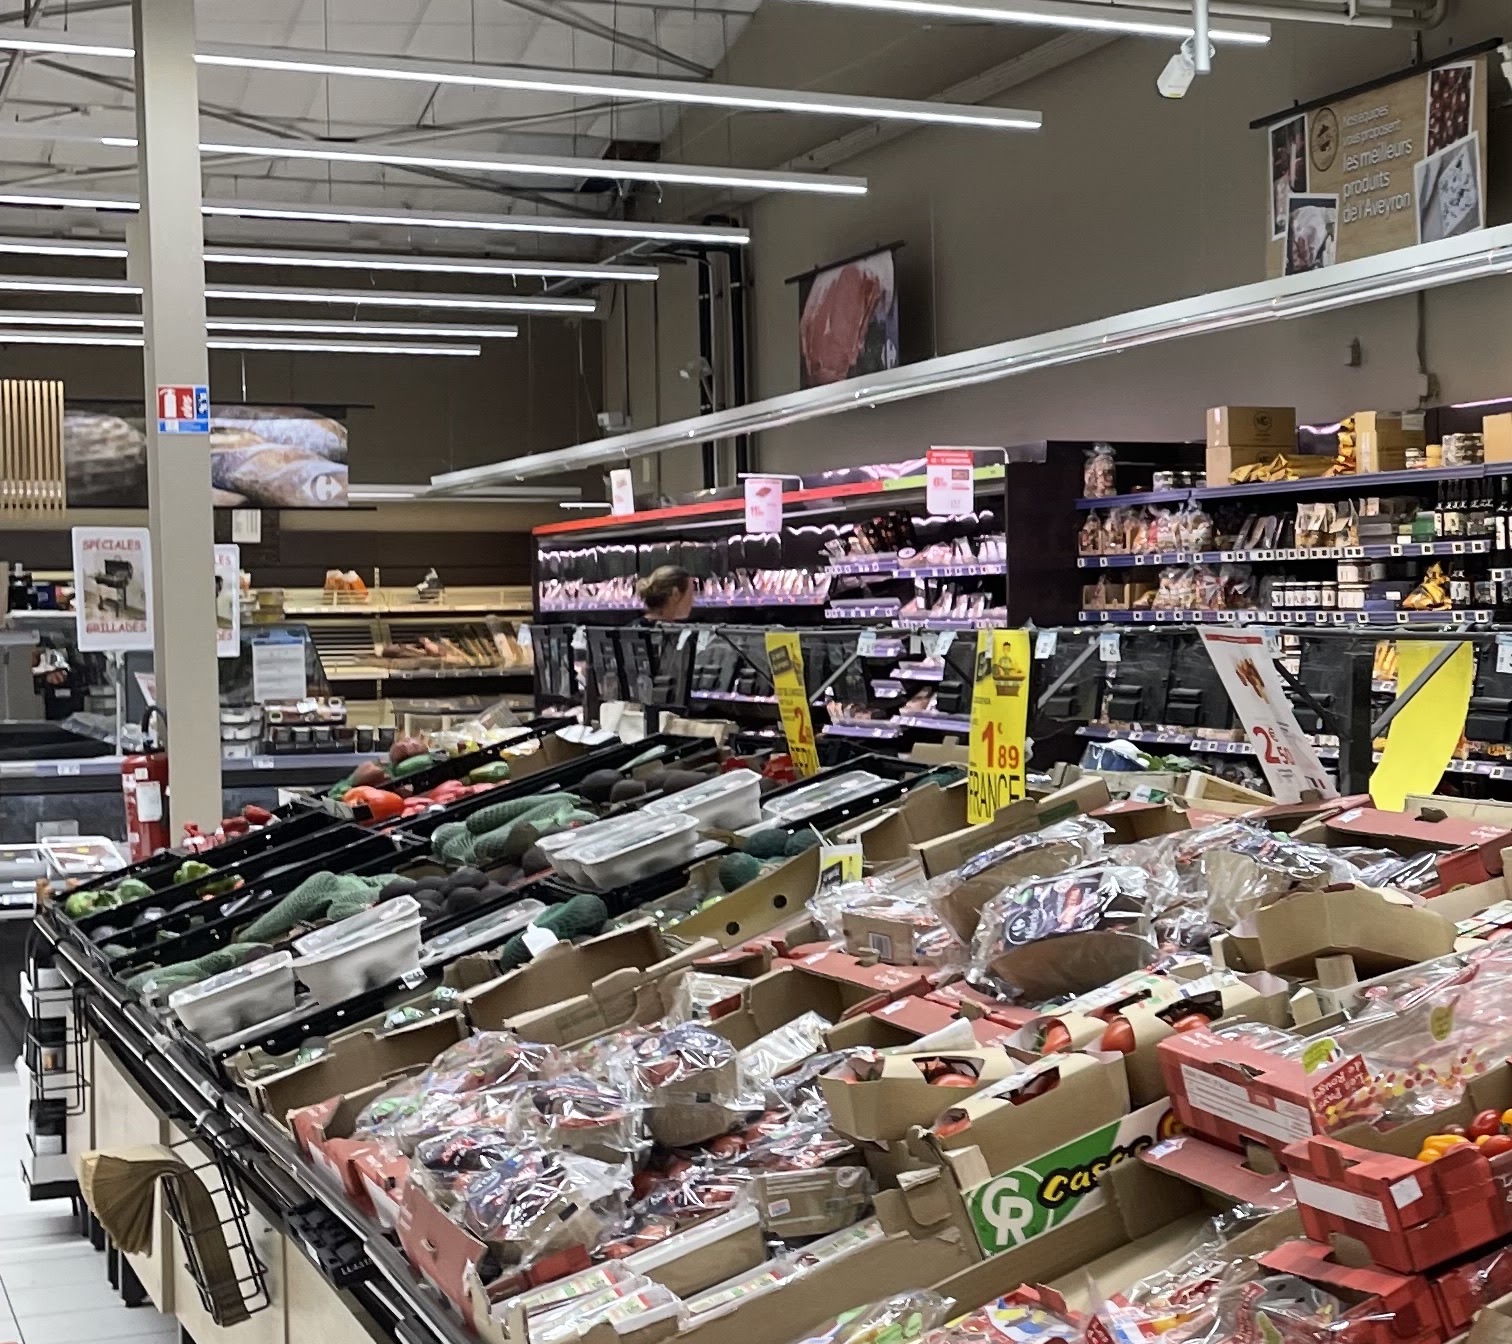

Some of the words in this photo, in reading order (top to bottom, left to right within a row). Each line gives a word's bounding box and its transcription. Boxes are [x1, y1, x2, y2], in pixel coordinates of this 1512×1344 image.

[1343, 152, 1359, 174] les
[1360, 138, 1413, 167] meilleurs
[1343, 171, 1391, 201] produits
[1343, 204, 1358, 224] de
